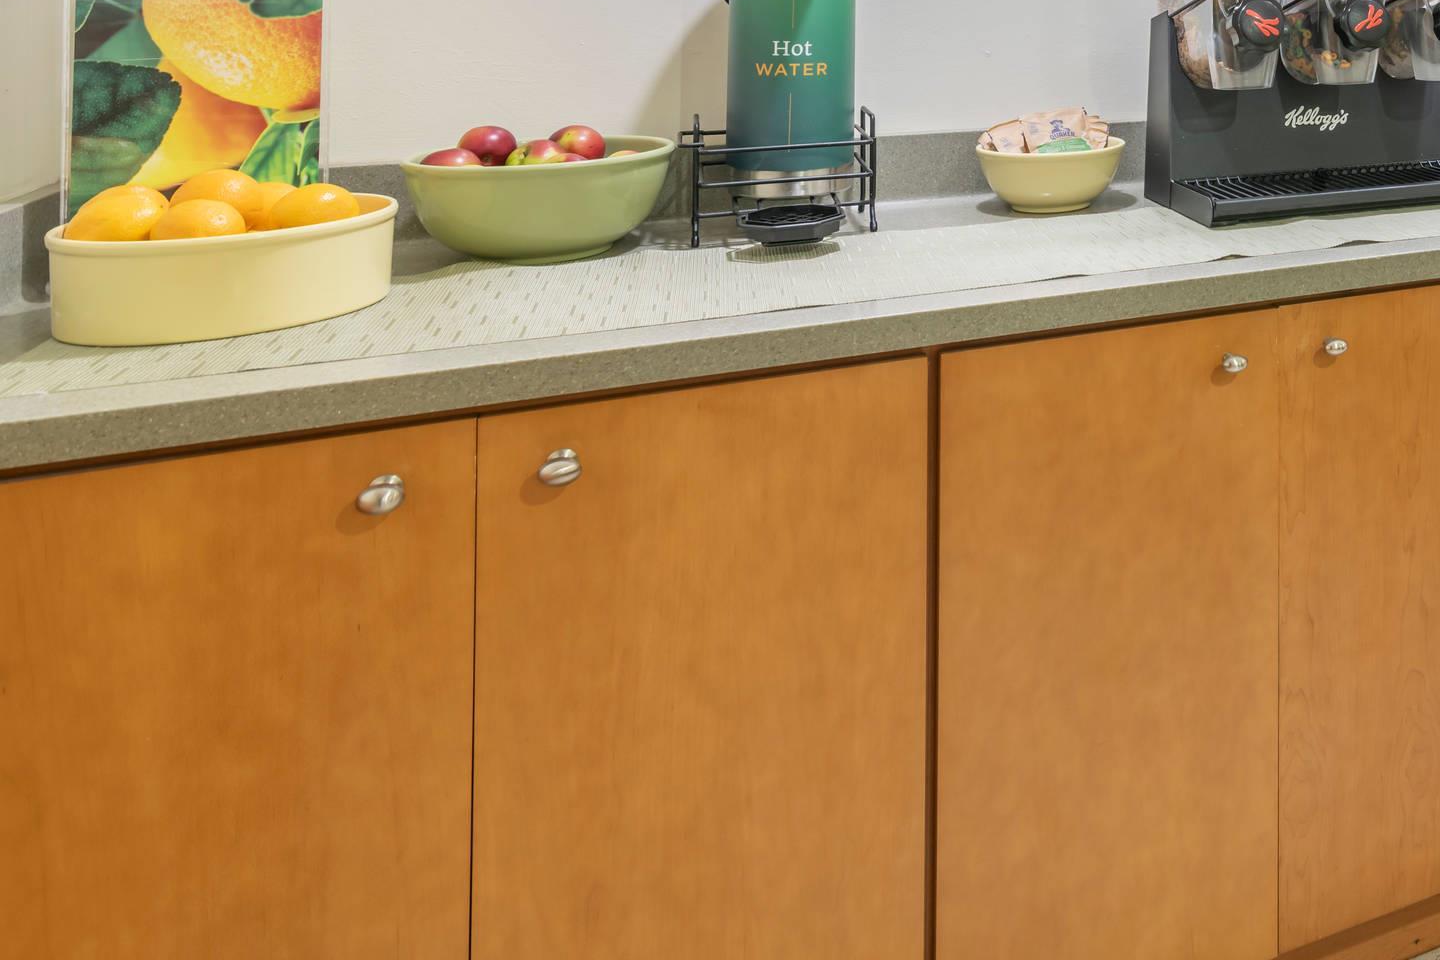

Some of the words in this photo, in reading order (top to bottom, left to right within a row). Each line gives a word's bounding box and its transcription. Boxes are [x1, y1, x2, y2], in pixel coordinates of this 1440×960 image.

[771, 40, 813, 56] Hot
[754, 63, 828, 77] WATER
[1285, 105, 1349, 131] Kellogg's
